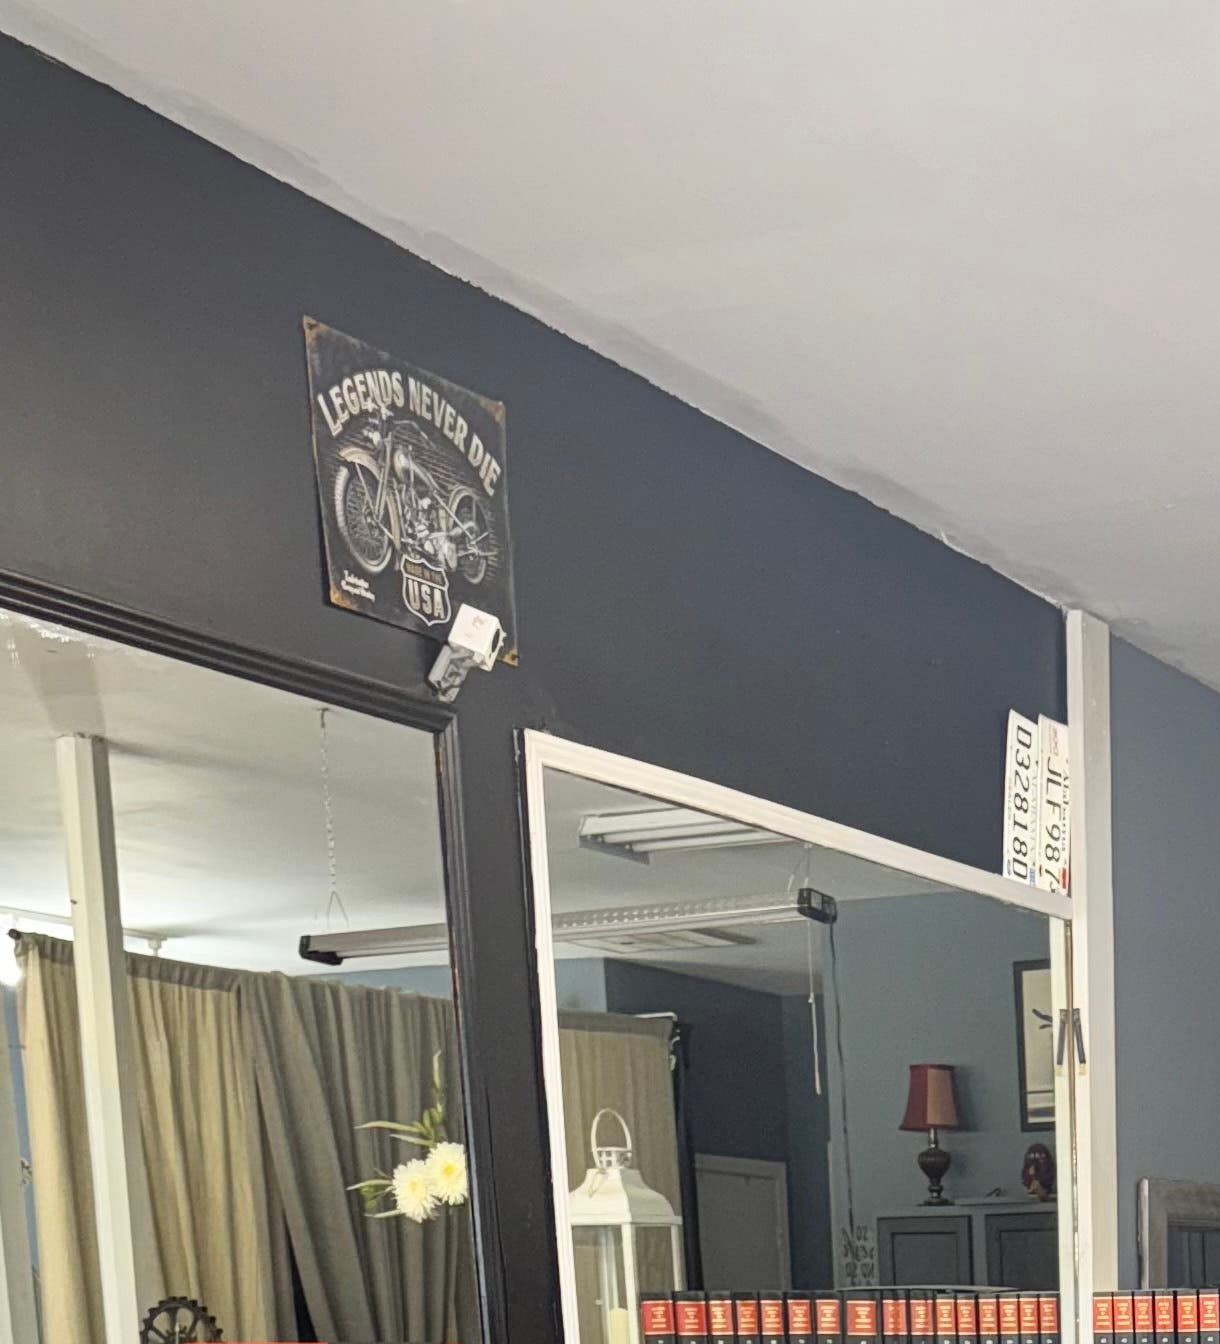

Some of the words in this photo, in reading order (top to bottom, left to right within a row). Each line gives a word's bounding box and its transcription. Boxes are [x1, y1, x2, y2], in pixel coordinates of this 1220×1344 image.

[317, 370, 405, 437] LEGENDS
[408, 376, 469, 453] NEVER
[467, 433, 502, 497] DIE
[408, 579, 446, 620] USA
